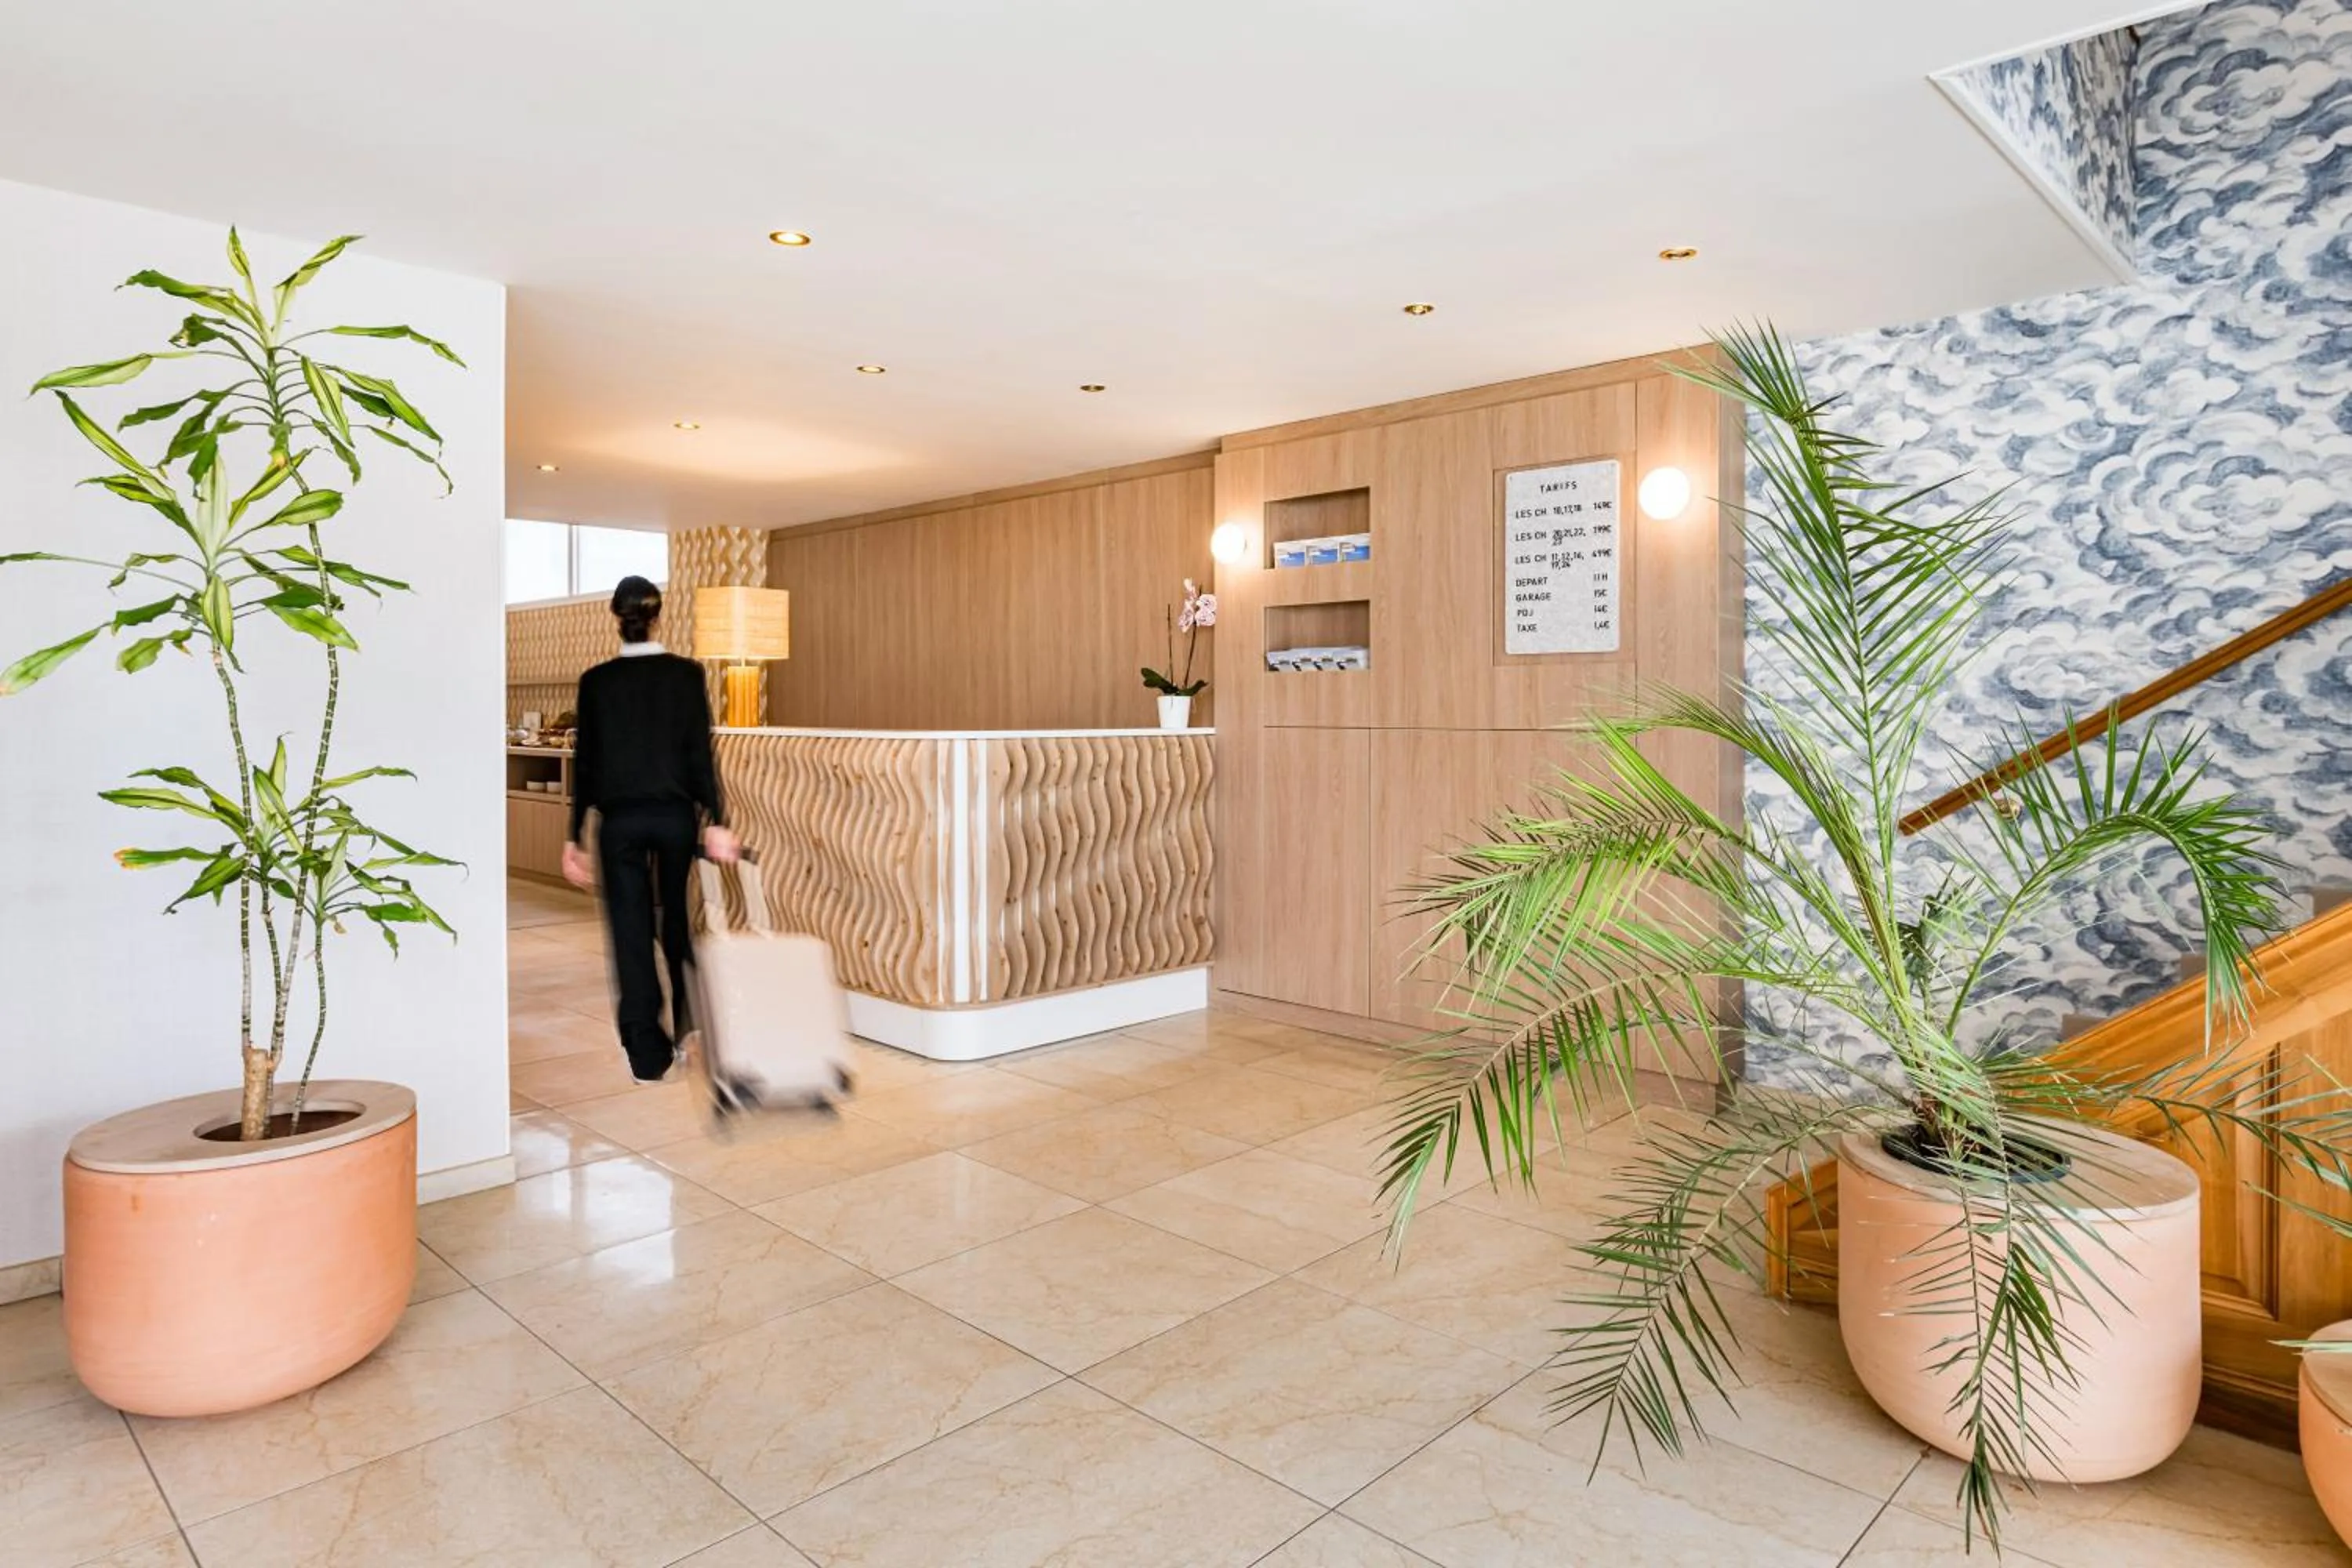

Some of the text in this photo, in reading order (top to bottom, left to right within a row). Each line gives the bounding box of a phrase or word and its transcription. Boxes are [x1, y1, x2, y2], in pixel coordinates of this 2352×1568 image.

[1540, 481, 1577, 493] TARIFS
[1515, 509, 1532, 519] LES
[1534, 507, 1547, 517] CH
[1515, 532, 1532, 542] LES
[1534, 531, 1547, 540] CH
[1515, 554, 1531, 564] LES
[1534, 554, 1547, 562] CH
[1515, 576, 1548, 587] DEPART
[1515, 592, 1552, 602] GARAGE
[1517, 623, 1537, 633] TAXE
